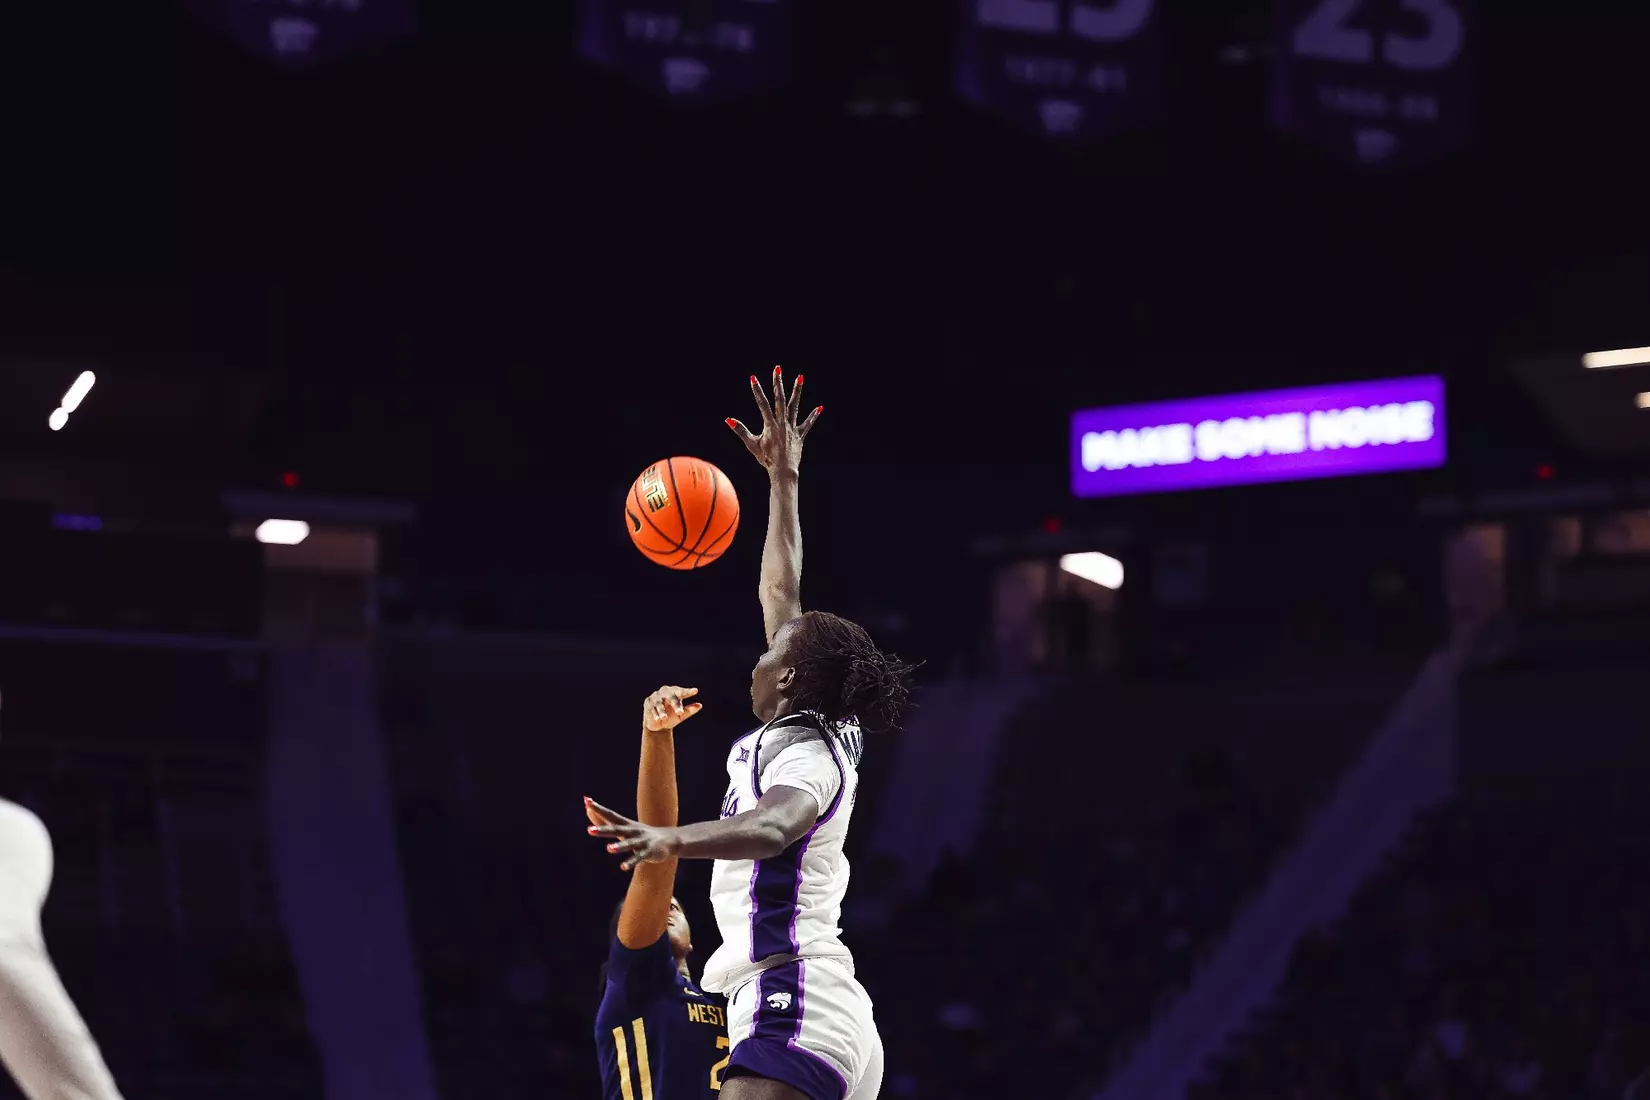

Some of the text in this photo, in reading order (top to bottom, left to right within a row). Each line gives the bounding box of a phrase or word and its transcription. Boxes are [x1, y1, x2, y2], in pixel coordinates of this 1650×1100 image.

[1081, 400, 1435, 472] MAKE SOME NOISE
[687, 1002, 724, 1026] WEST
